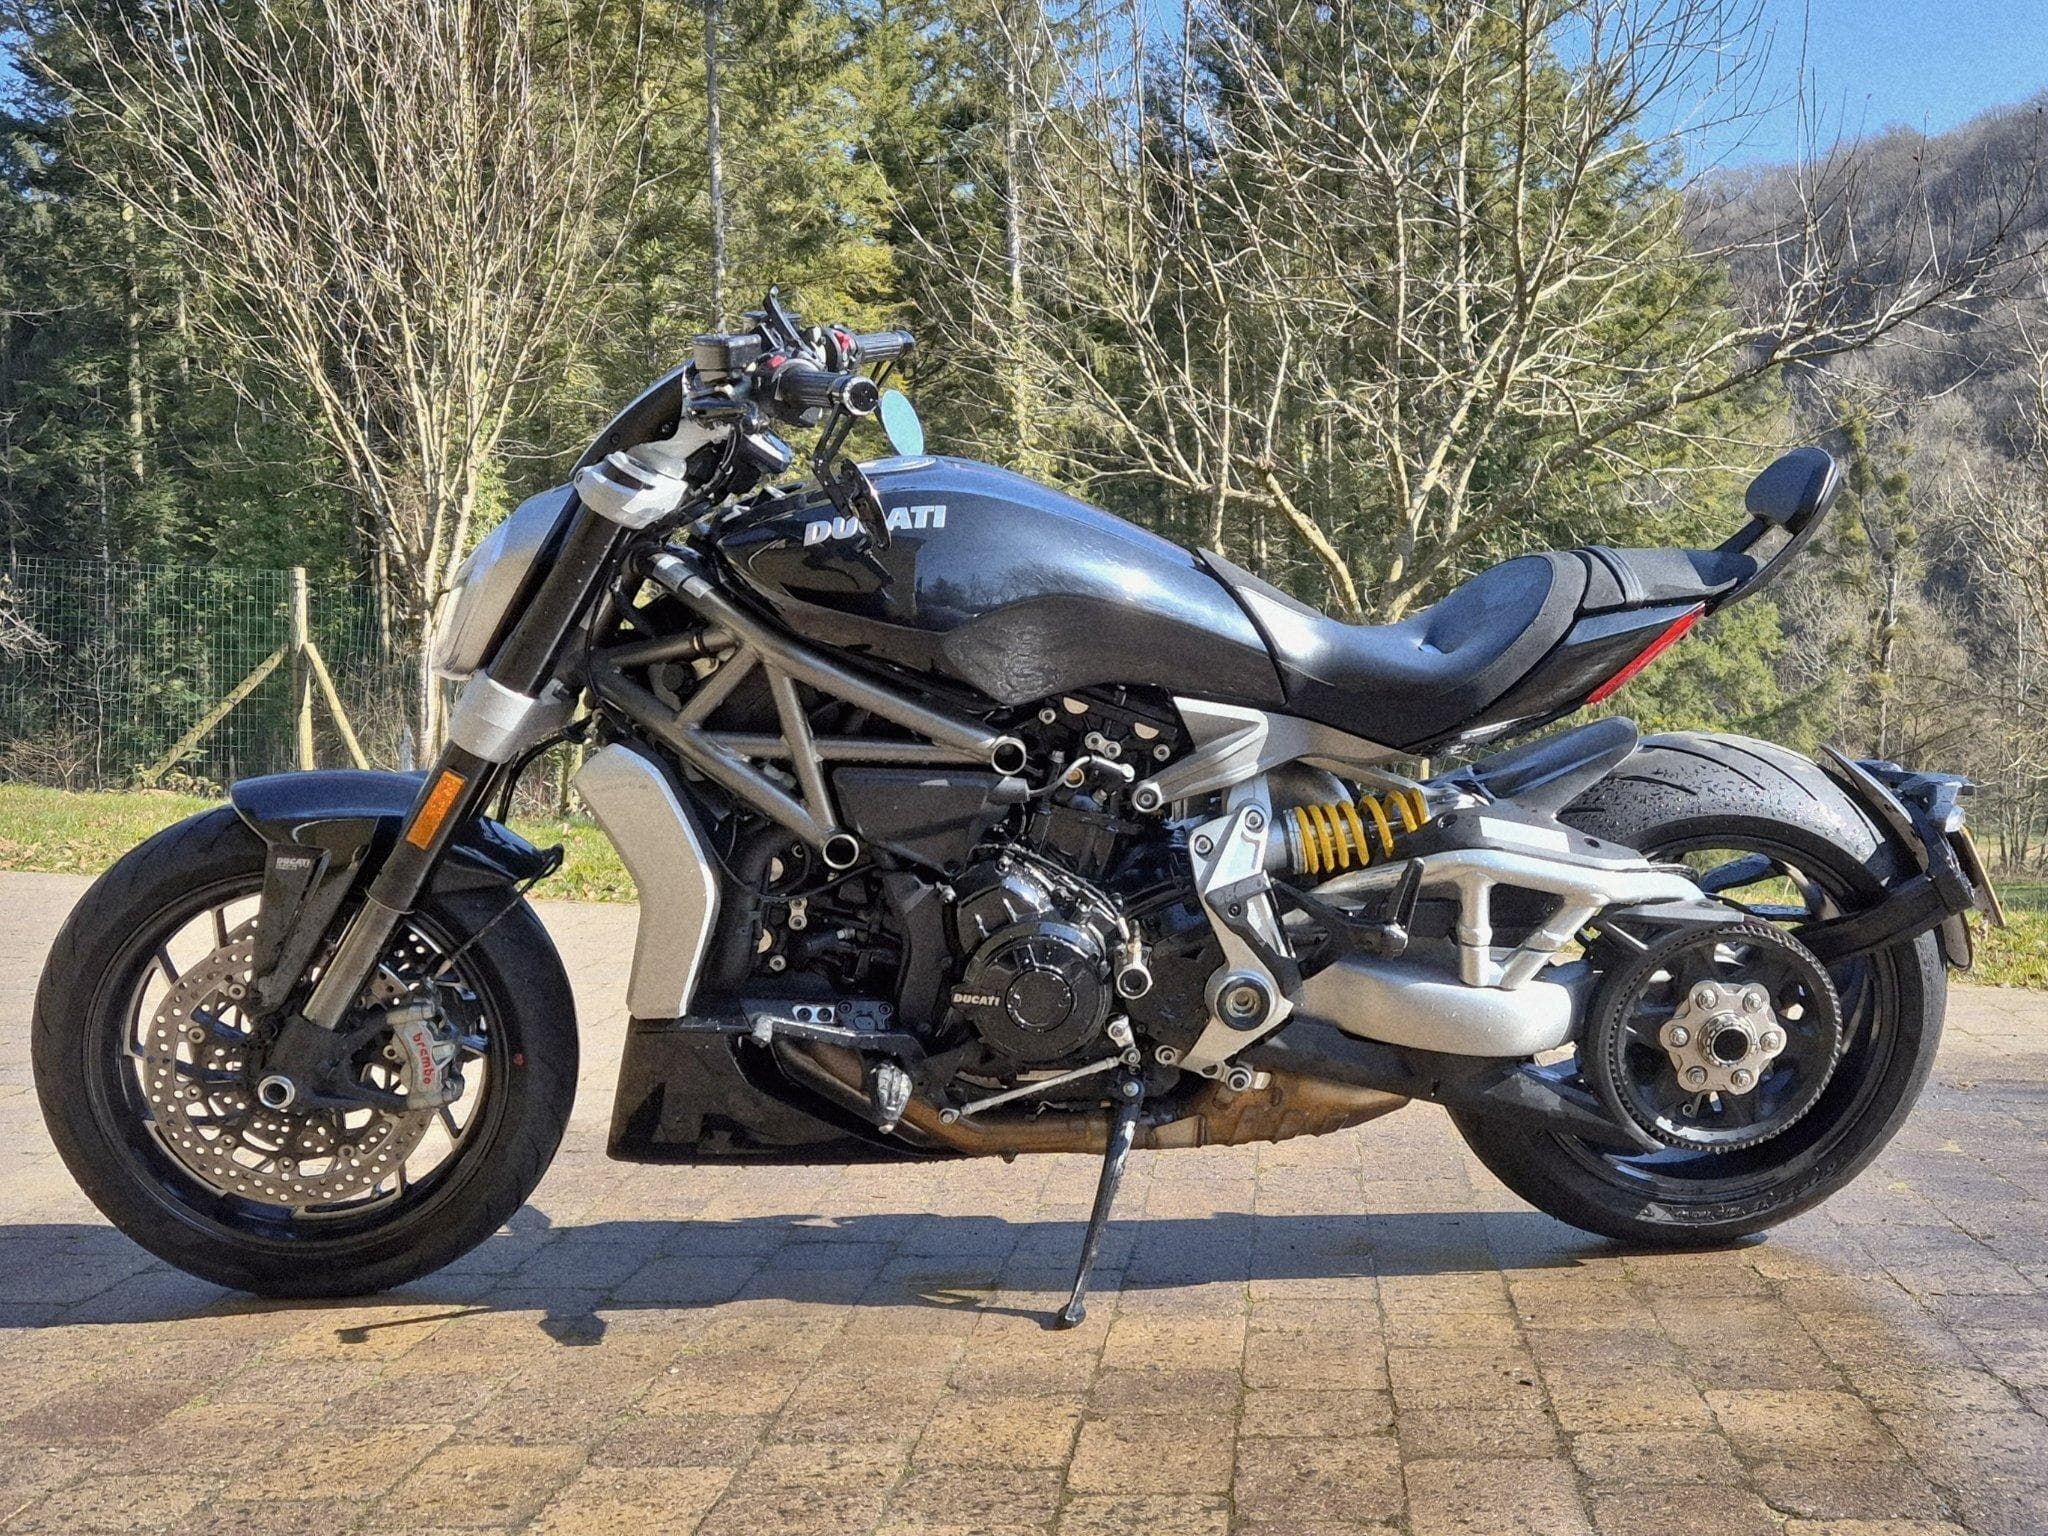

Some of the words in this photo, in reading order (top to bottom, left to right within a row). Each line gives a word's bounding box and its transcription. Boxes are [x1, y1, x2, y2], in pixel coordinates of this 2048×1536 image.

[803, 505, 947, 547] DUATI
[953, 993, 1000, 1006] DUCATI
[412, 1031, 435, 1085] brembo
